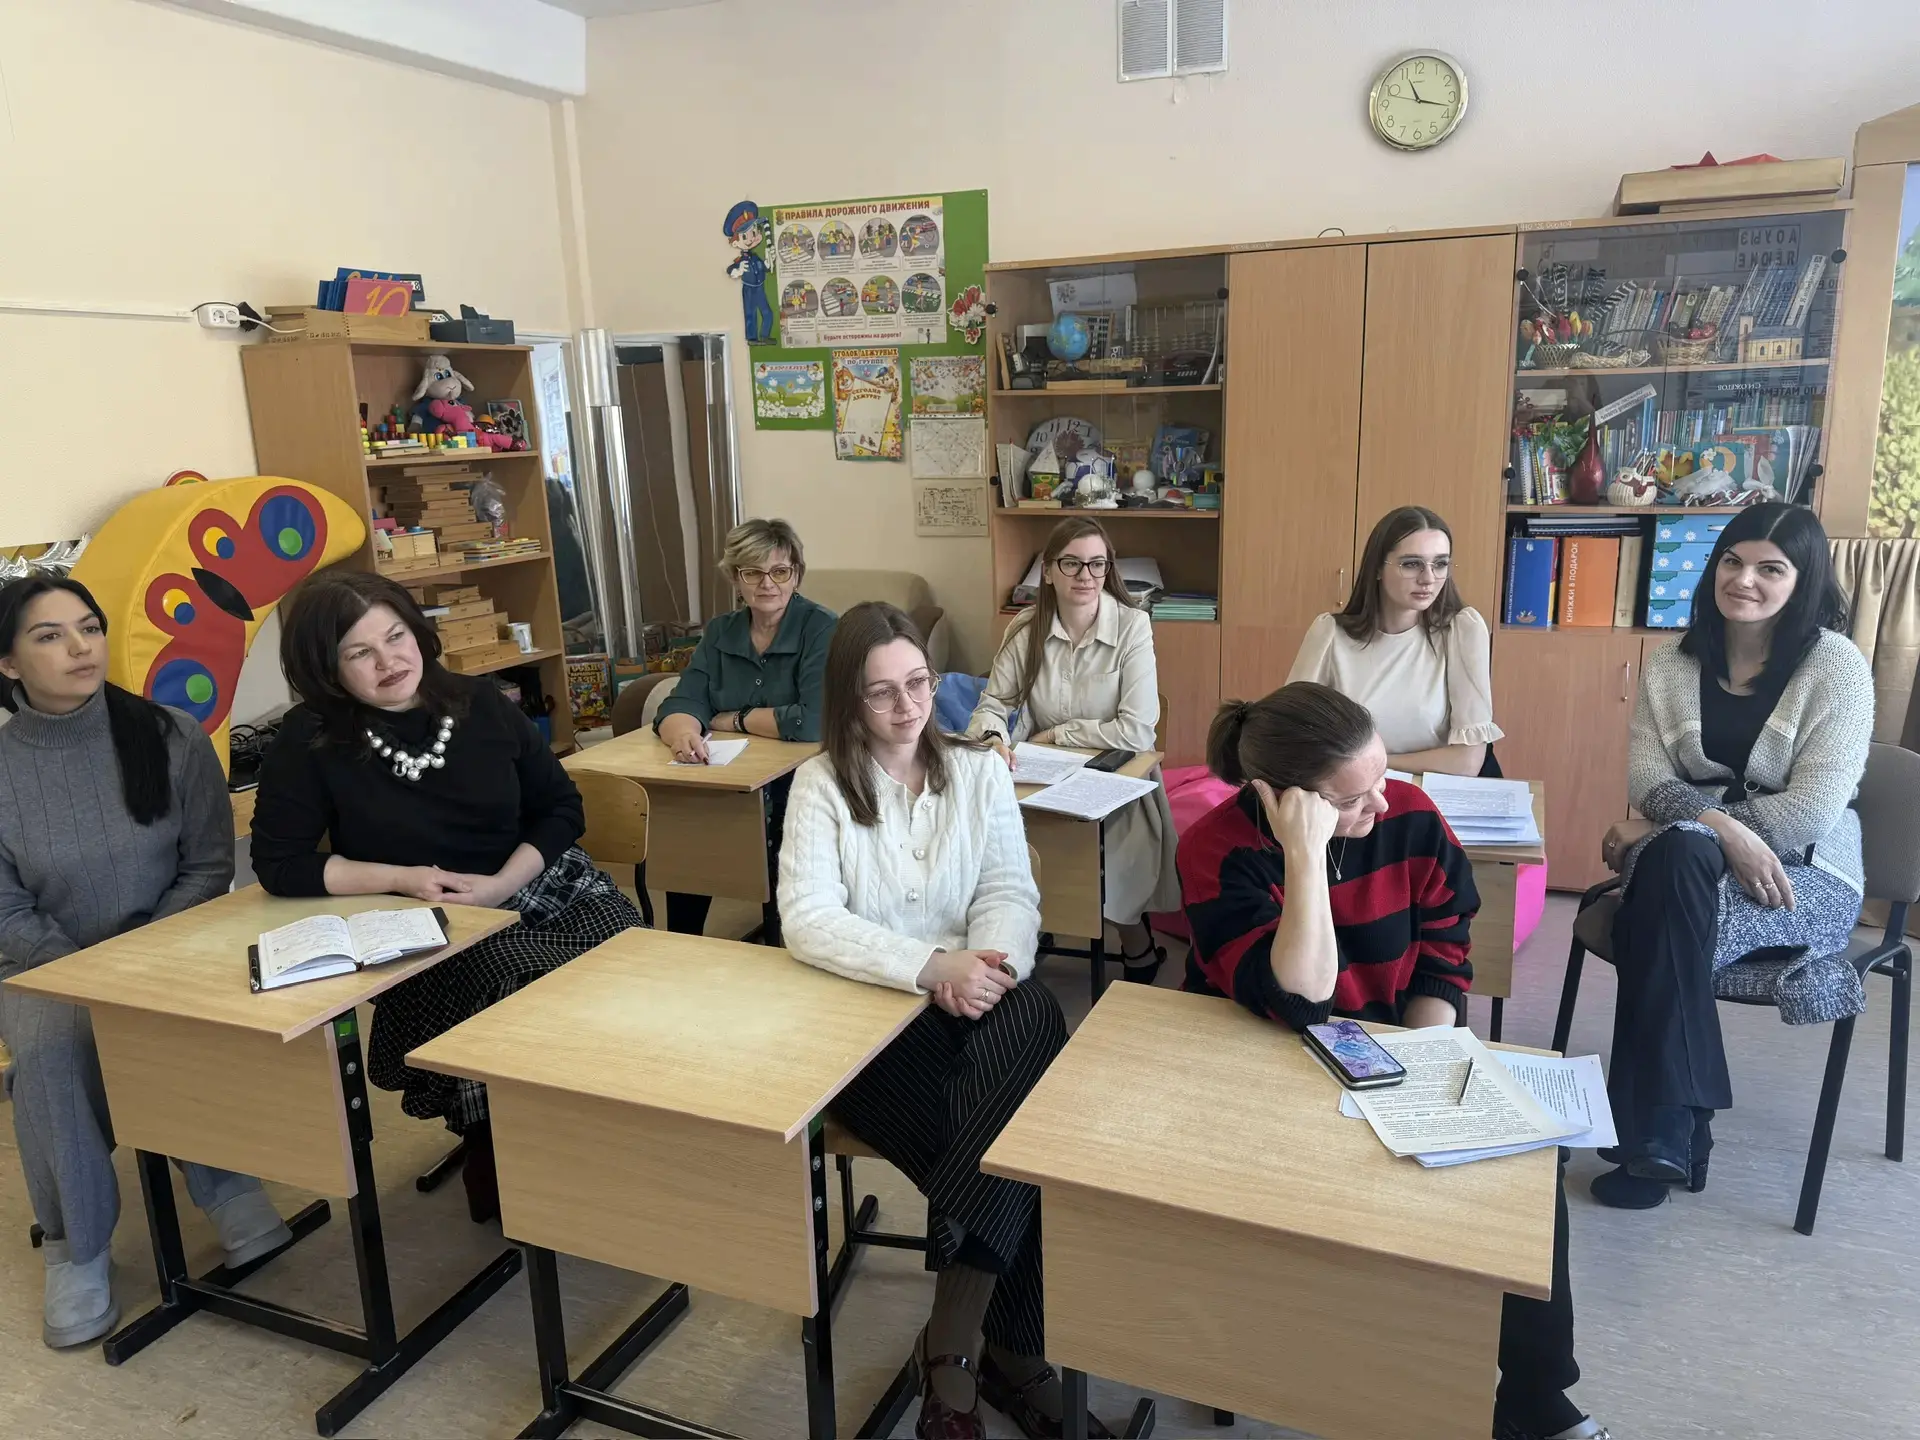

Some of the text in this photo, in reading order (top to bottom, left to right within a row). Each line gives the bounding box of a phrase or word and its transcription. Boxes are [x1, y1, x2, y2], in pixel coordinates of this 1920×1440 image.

[1401, 67, 1409, 80] 11
[1414, 61, 1425, 75] 12
[1435, 63, 1440, 75] 1
[1443, 74, 1452, 87] 2
[1385, 84, 1401, 96] 10
[1448, 91, 1456, 103] 3
[1380, 98, 1389, 111] 9
[1441, 108, 1452, 119] 4
[1386, 115, 1395, 128] 8
[1429, 121, 1439, 134] 5
[1399, 125, 1407, 138] 7
[1413, 128, 1422, 141] 6
[785, 200, 930, 221] ПРАВИЛА ДОРОЖНОГО ДВИЖЕНИЯ
[880, 331, 902, 340] дороге!
[861, 348, 898, 357] ДЕЖУРНЫХ
[1067, 419, 1080, 432] 12
[1035, 431, 1048, 442] 10
[1569, 542, 1579, 581] ПОДАРОК
[1566, 589, 1576, 623] КНИЖКИ
